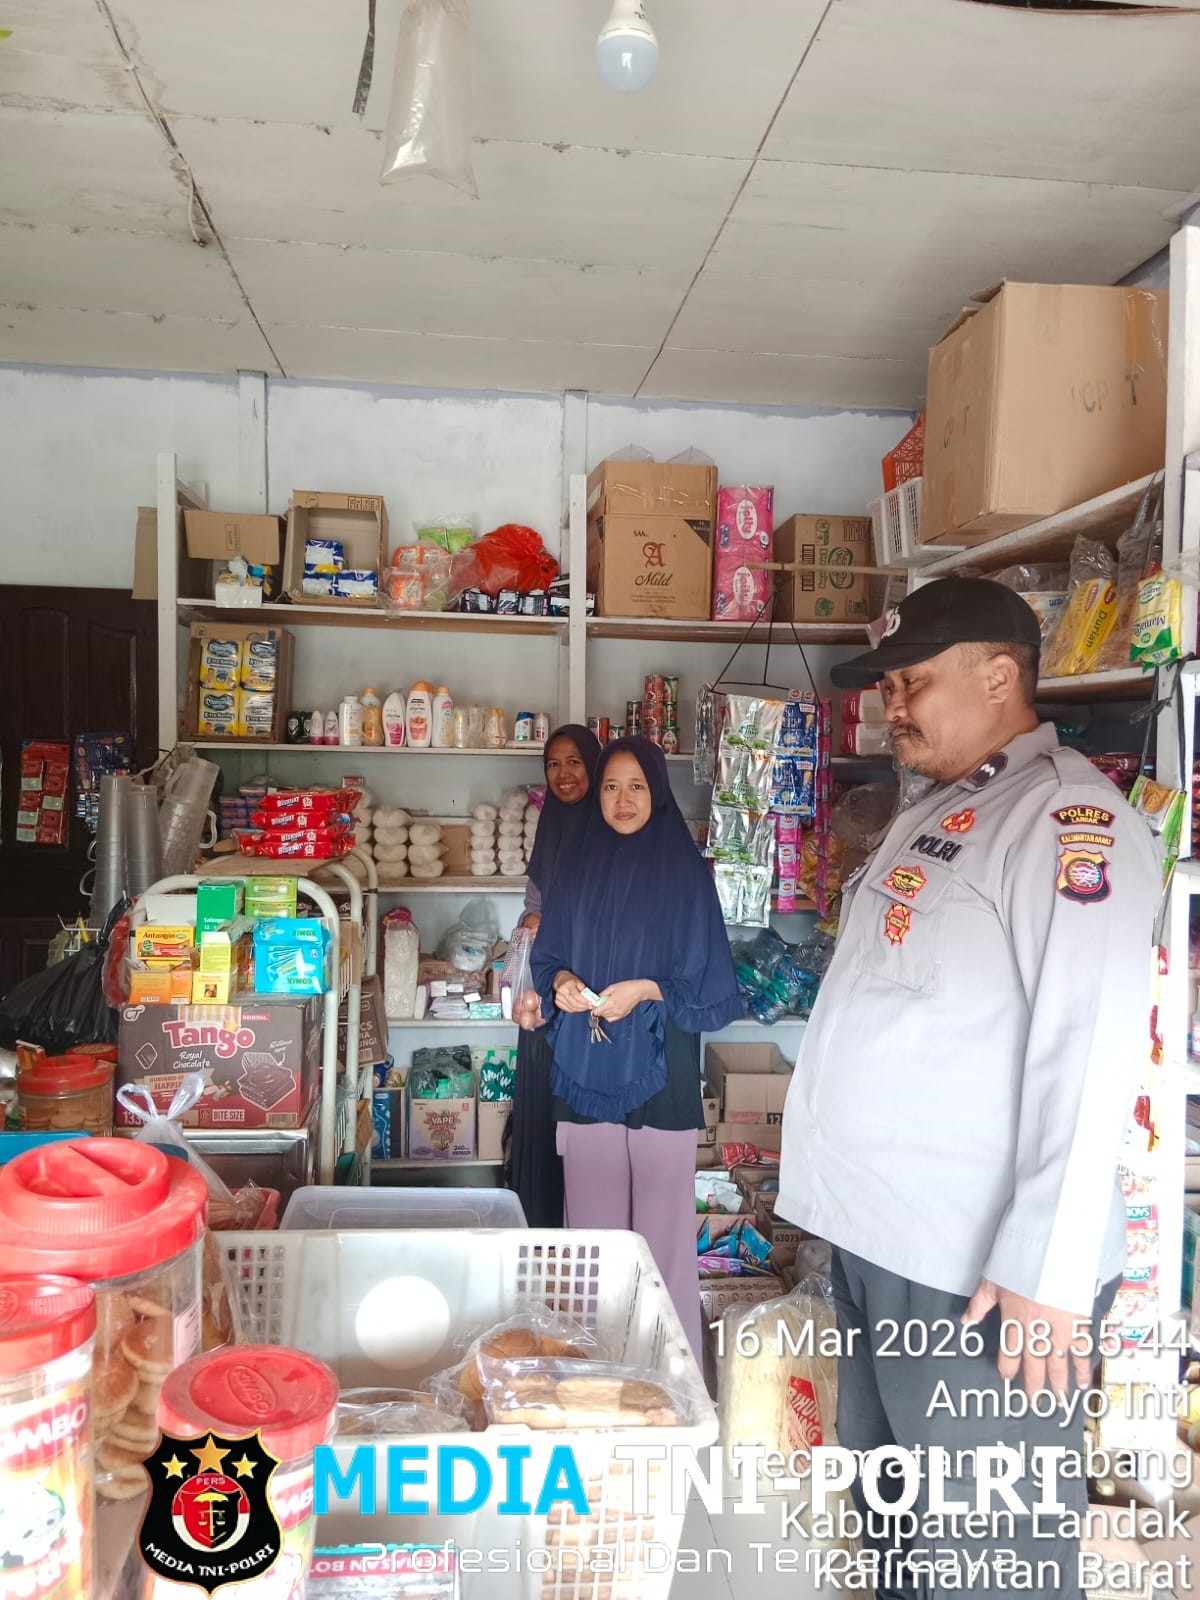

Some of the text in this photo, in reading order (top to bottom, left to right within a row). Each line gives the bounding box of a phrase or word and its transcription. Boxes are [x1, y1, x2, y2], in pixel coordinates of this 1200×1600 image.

[643, 541, 667, 568] A
[634, 571, 674, 587] Mild
[1086, 610, 1108, 648] Durian
[1059, 807, 1110, 821] POLRES
[909, 834, 963, 862] POLRI
[143, 932, 175, 940] Antangin
[162, 1020, 255, 1058] Tango
[179, 1050, 203, 1060] Royal
[172, 1058, 211, 1069] Chocolate
[213, 1110, 244, 1120] BITE SIZE
[774, 1234, 800, 1243] 63073
